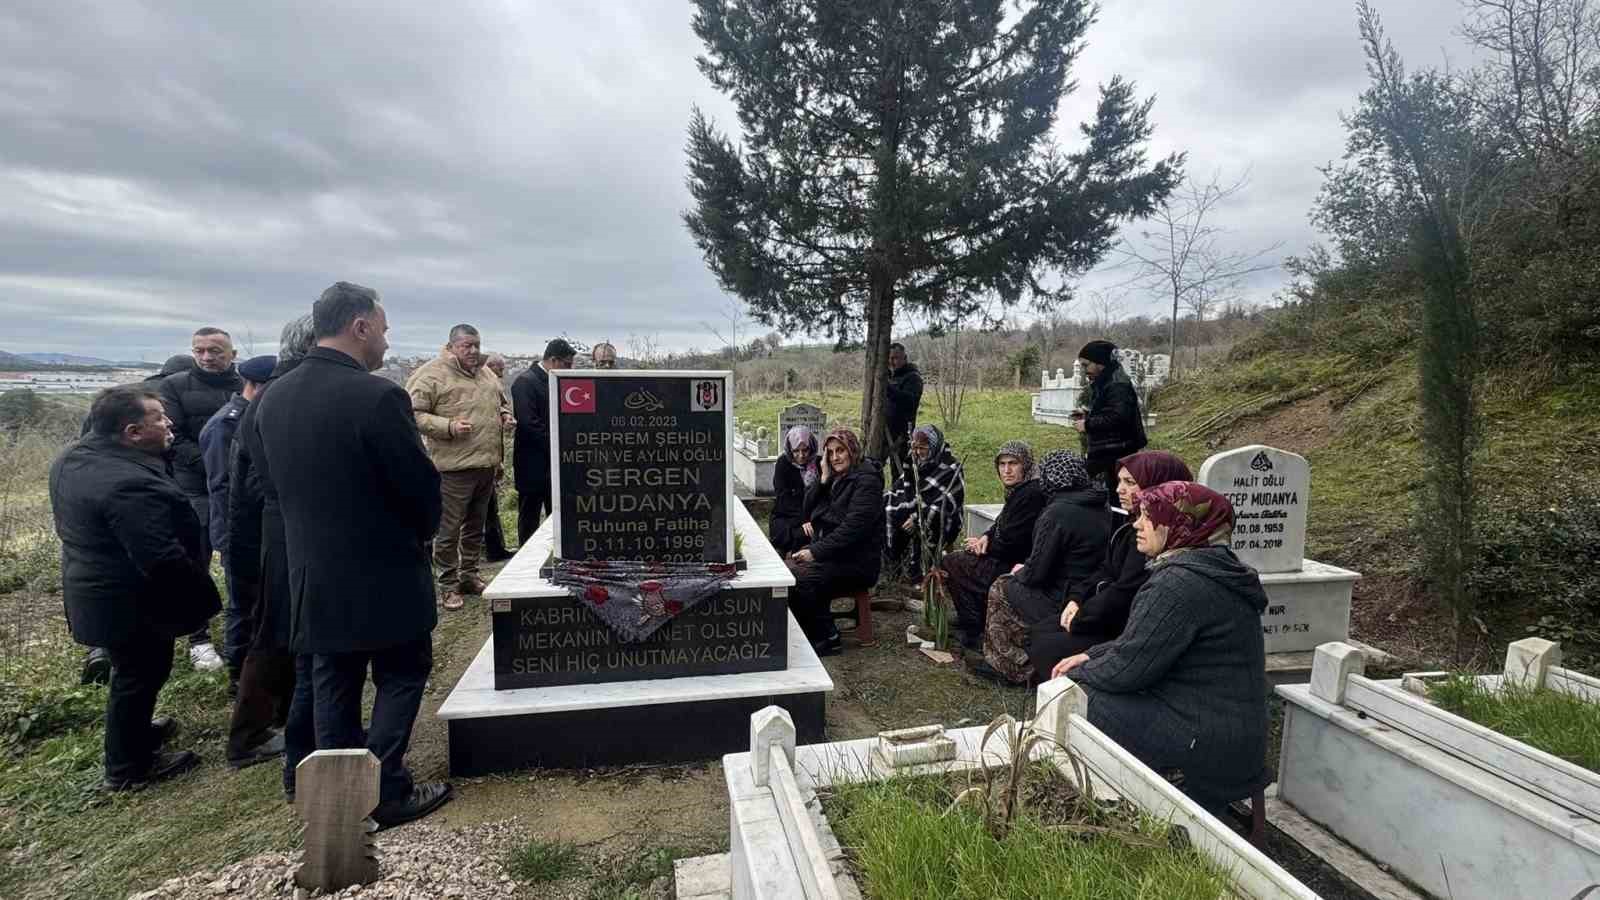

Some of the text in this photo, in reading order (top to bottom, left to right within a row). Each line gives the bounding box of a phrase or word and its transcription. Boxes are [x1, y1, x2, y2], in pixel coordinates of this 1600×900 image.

[611, 415, 677, 427] 06.02.2023
[576, 428, 711, 447] DEPREM ŞEHİDİ
[562, 446, 722, 464] METİN VE AYLİN OĞLU
[586, 467, 700, 487] SERGEN
[1233, 474, 1285, 488] HALİT OĞLU
[576, 492, 712, 513] MUDANYA
[1251, 491, 1298, 507] MUDANYA
[578, 517, 710, 534] Ruhuna Fatiha
[584, 534, 705, 552] D.11.10.1996
[519, 630, 609, 650] MEKANIN
[701, 621, 764, 639] OLSUN
[512, 641, 771, 676] SENİ HİÇ UNUTMAYACAĞIZ
